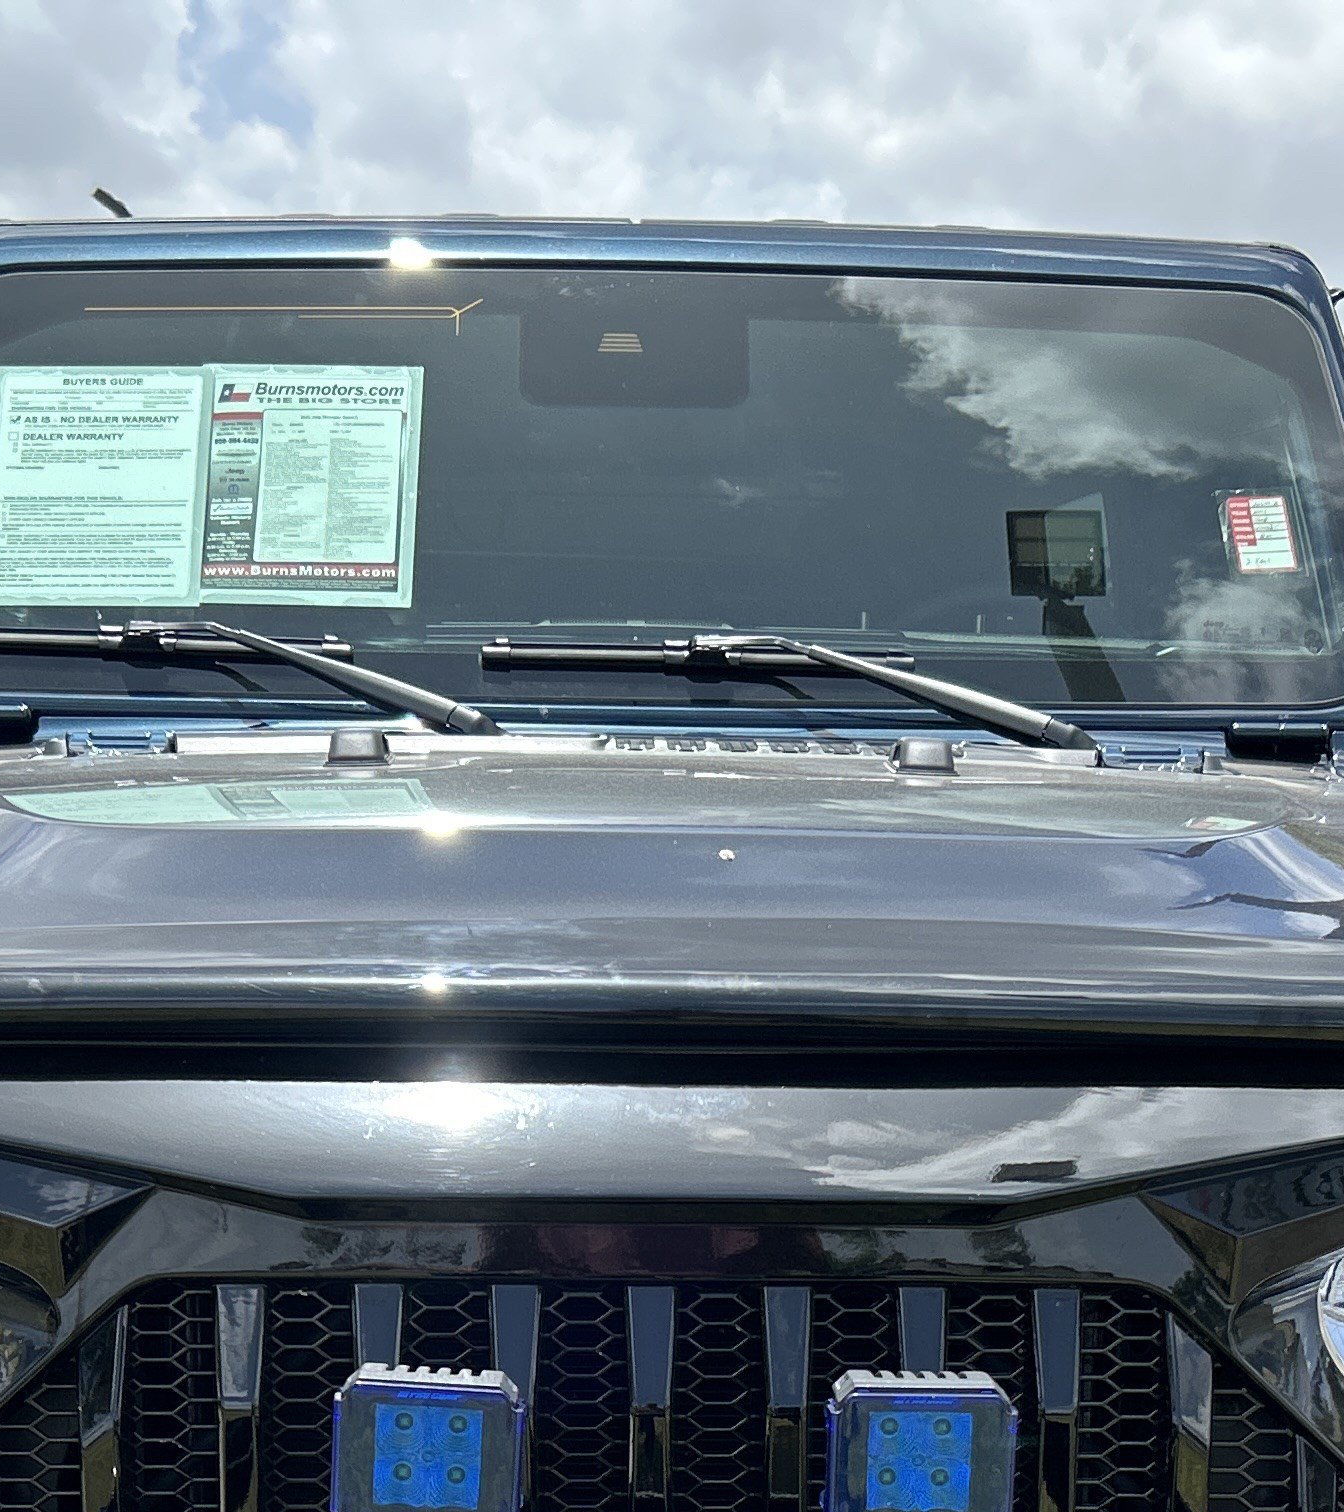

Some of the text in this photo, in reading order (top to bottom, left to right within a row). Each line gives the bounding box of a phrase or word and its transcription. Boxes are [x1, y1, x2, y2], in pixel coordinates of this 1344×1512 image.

[62, 378, 144, 386] BUYERS GUIDE
[24, 416, 38, 424] AS
[41, 416, 51, 424] IS
[60, 416, 76, 424] NO
[78, 416, 119, 424] DEALER
[121, 415, 179, 424] WARRANTY
[22, 432, 125, 441] DEALER WARRANTY
[203, 565, 397, 578] www.BurnsMotors.com
